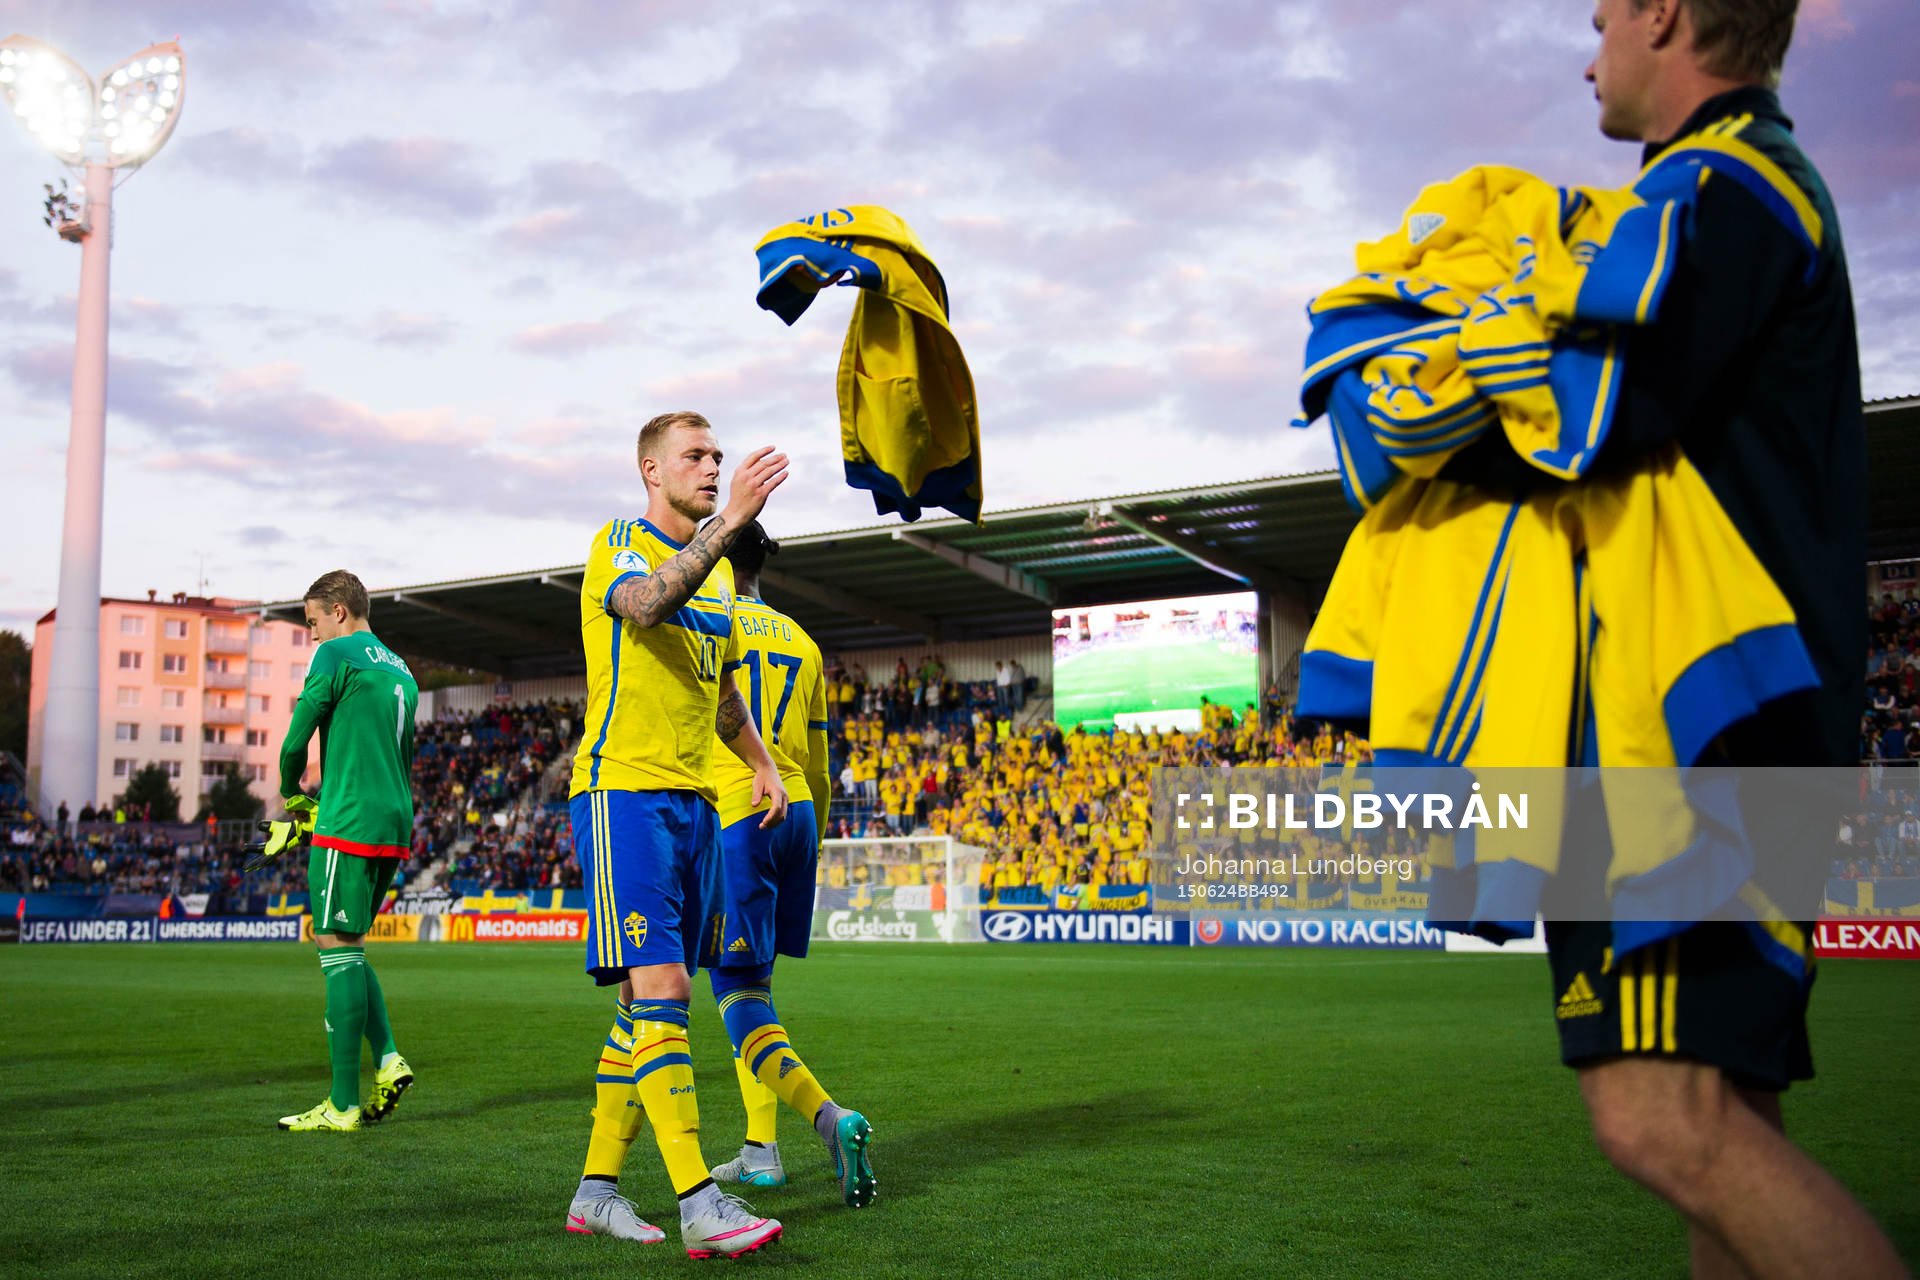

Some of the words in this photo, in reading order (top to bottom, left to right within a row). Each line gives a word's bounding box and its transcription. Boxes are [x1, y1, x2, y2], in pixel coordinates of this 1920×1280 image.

[739, 615, 792, 642] BAFFO
[741, 649, 803, 746] 17
[393, 683, 405, 751] 1
[69, 921, 127, 940] UNDER
[130, 921, 151, 940] 21
[160, 921, 223, 939] UHERSKE
[226, 920, 297, 939] HRADISTE
[476, 918, 579, 937] McDonald's
[827, 910, 917, 940] Carlsberg
[1034, 914, 1173, 942] HYUNDAI
[1238, 919, 1282, 943] NO
[1286, 919, 1323, 943] TO
